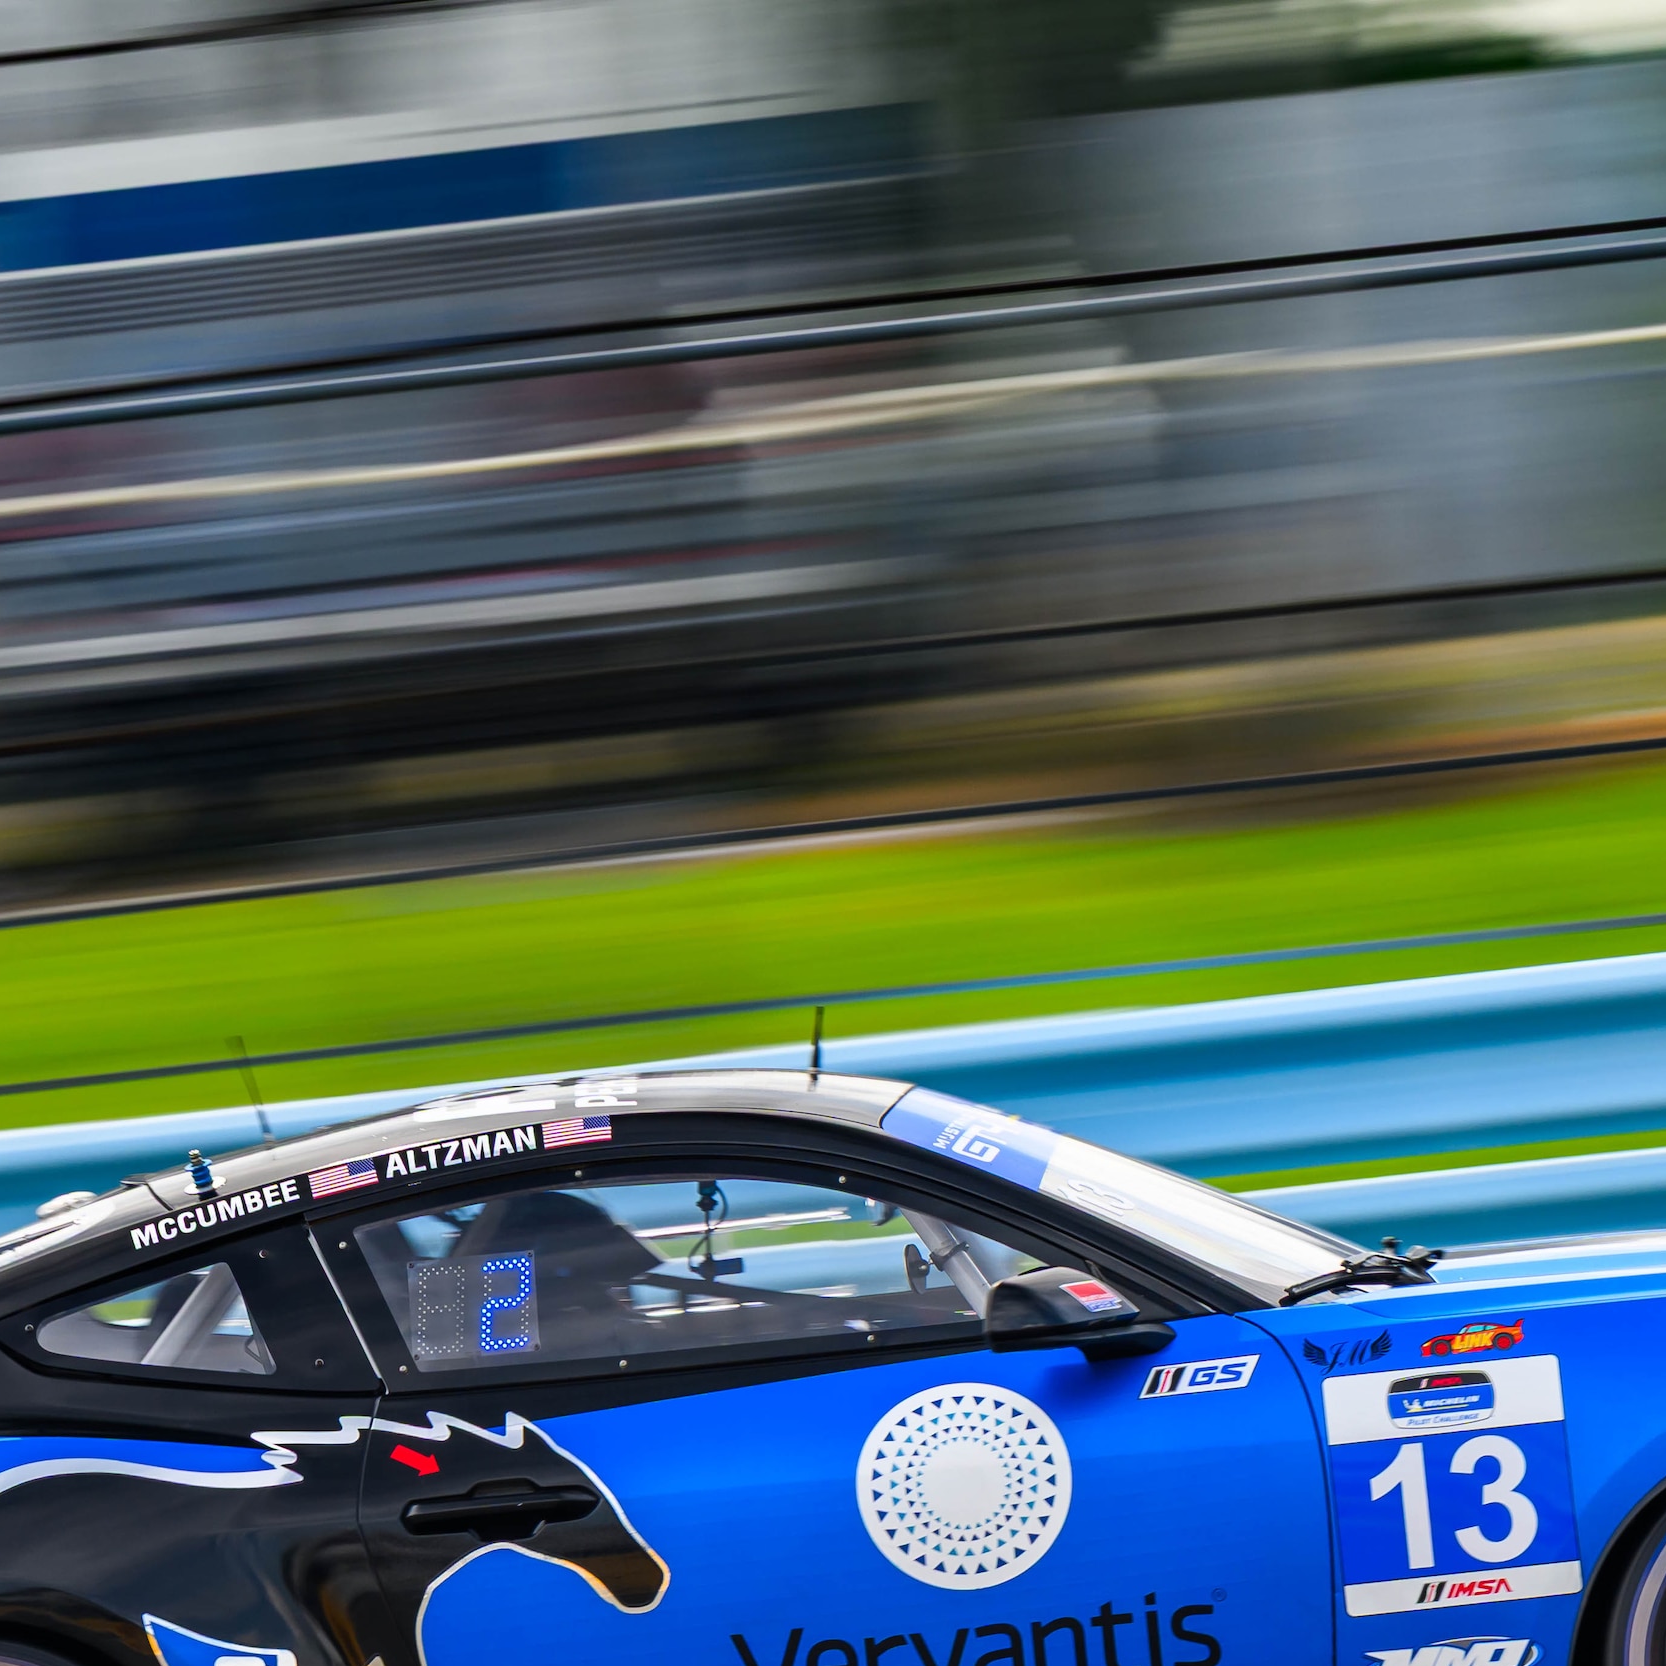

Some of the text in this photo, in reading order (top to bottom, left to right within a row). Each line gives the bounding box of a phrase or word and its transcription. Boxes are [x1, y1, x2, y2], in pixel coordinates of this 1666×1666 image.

[130, 1125, 536, 1250] MCCUMBEE ALTZMAN
[481, 1257, 531, 1351] 2
[1454, 1332, 1495, 1350] LINK
[1188, 1362, 1248, 1387] GS
[1369, 1434, 1539, 1570] 13
[1447, 1578, 1514, 1598] IMSA
